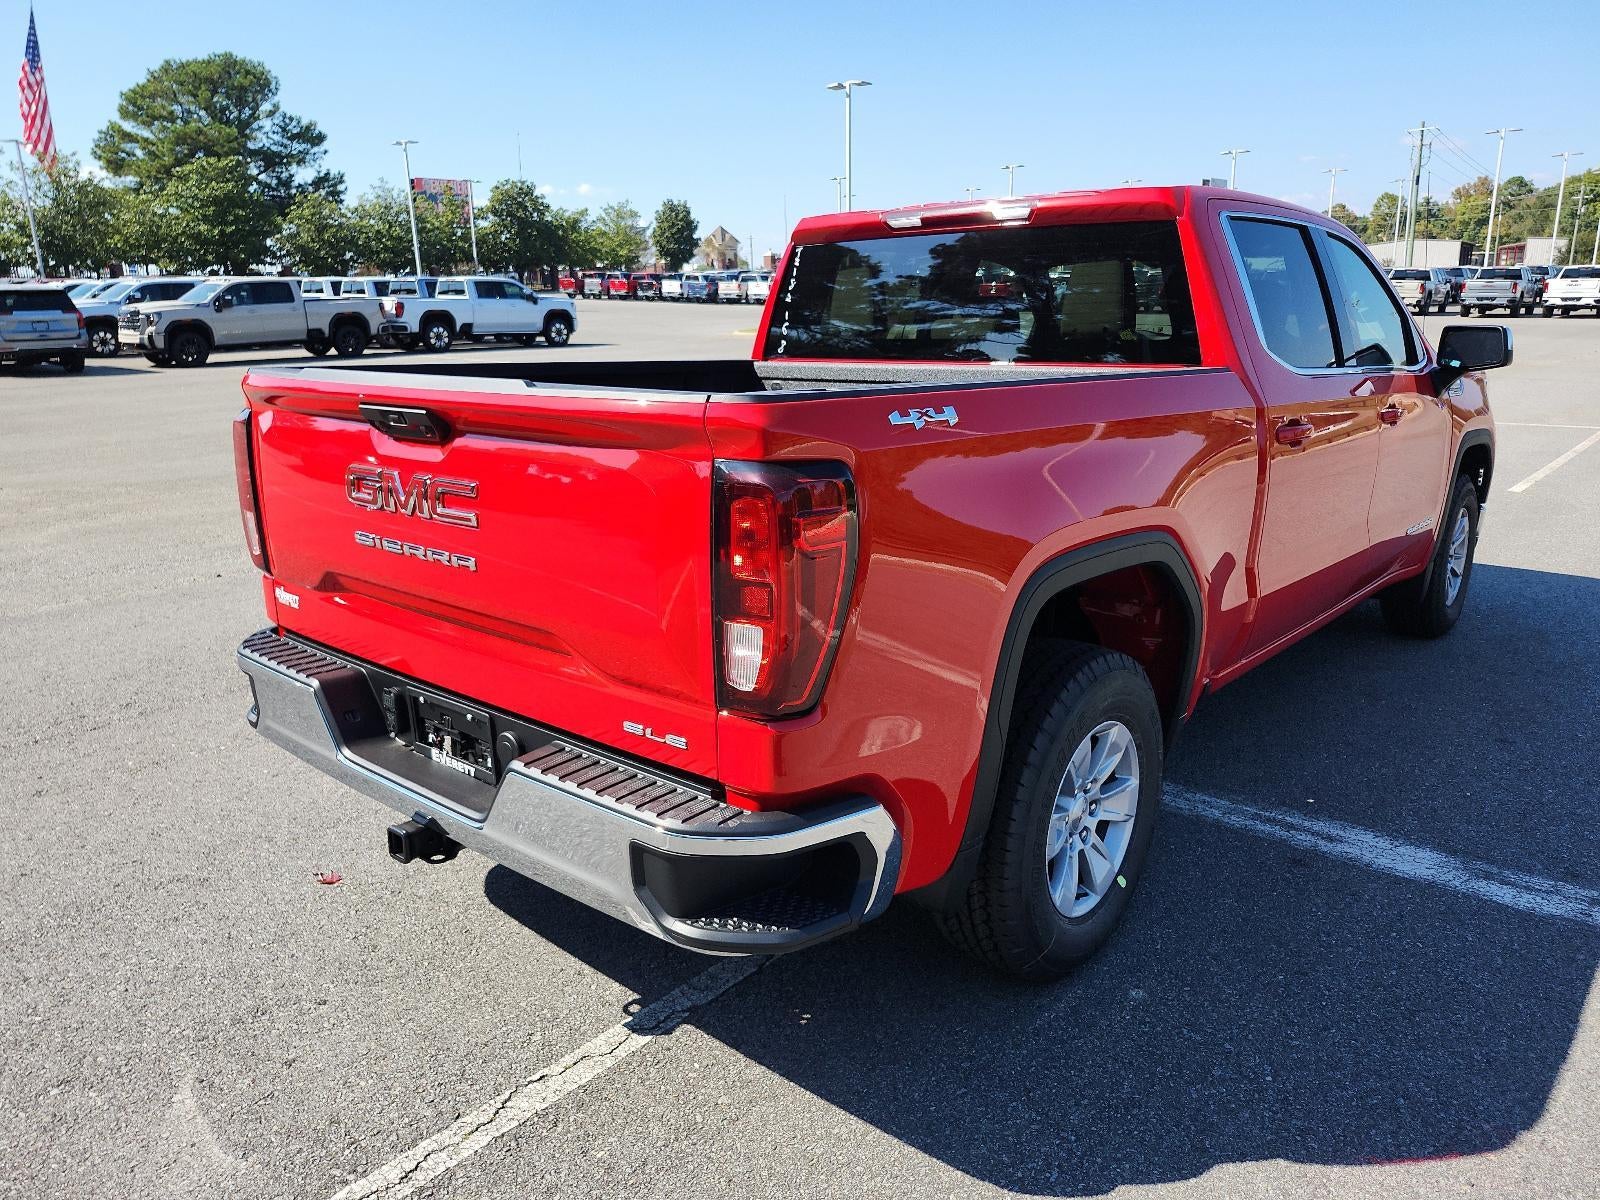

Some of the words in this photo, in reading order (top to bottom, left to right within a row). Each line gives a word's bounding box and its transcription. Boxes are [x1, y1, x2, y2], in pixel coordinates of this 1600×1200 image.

[345, 463, 480, 529] GMC
[354, 530, 478, 572] SIERRA
[622, 720, 688, 750] SLE
[431, 746, 476, 777] EVERETT
